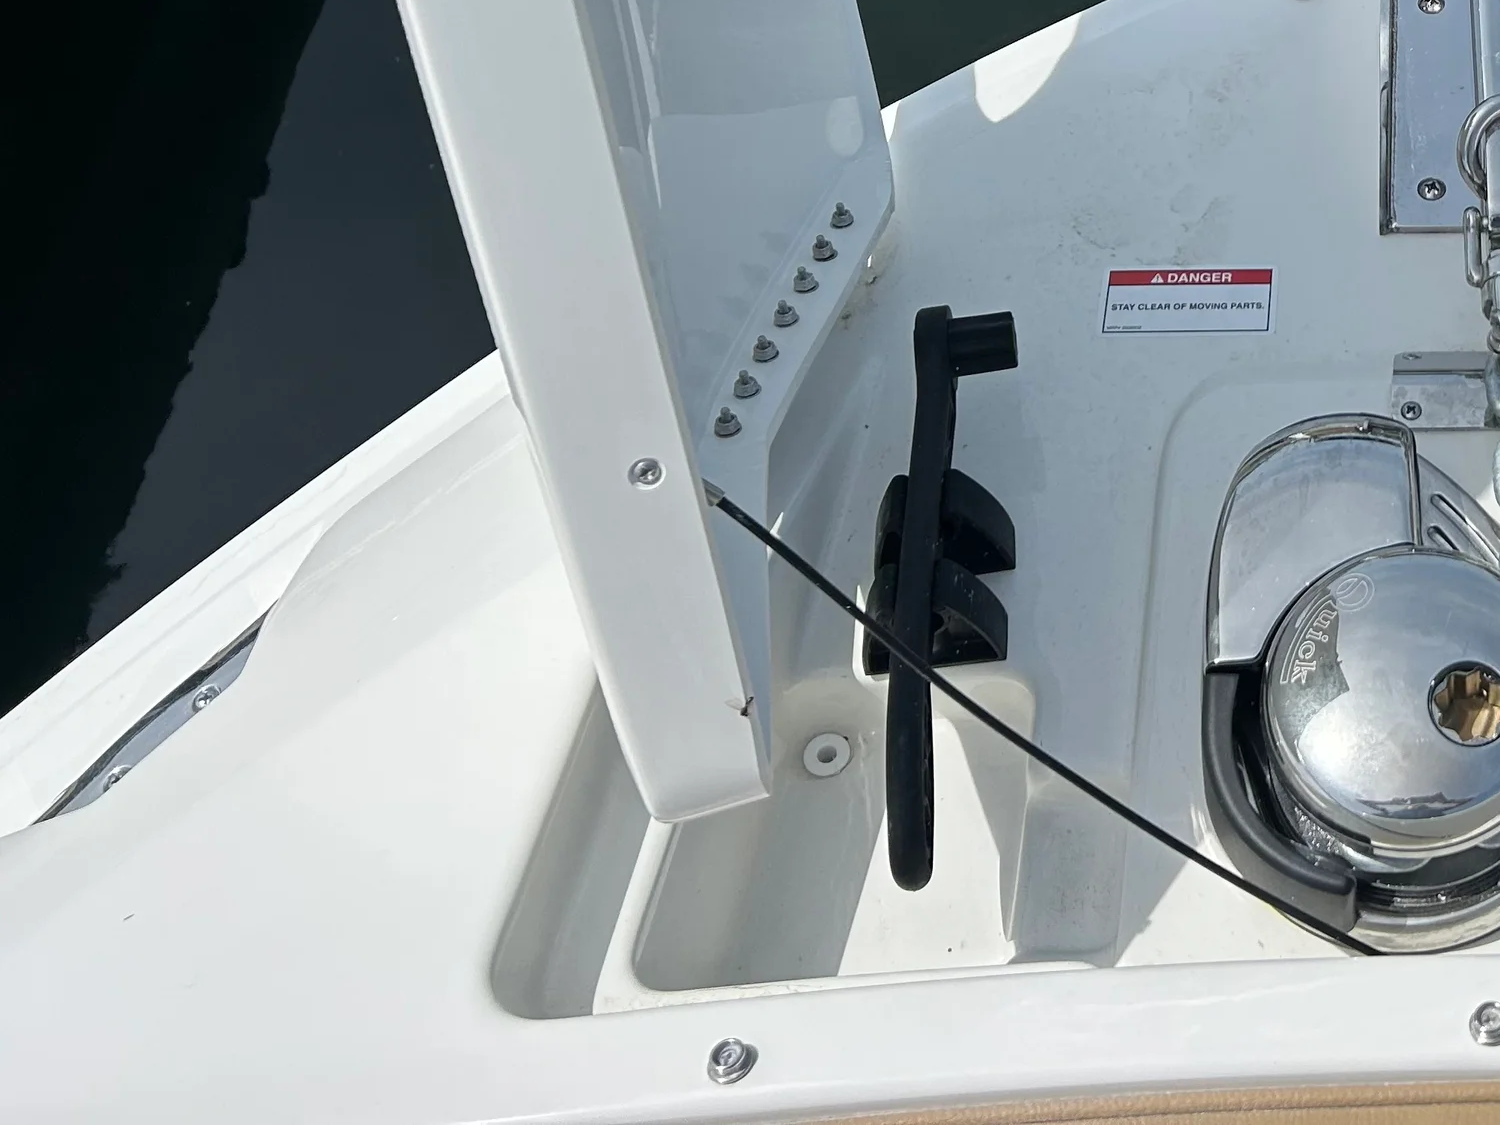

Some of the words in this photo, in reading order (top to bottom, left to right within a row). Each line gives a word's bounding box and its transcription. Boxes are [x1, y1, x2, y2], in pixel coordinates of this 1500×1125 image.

[1167, 272, 1233, 283] DANGER
[1111, 303, 1136, 311] STAY
[1138, 303, 1171, 311] CLEAR
[1173, 303, 1186, 311] OF
[1189, 302, 1228, 310] MOVING
[1230, 302, 1265, 310] PARTS.
[1280, 572, 1375, 685] Quick
